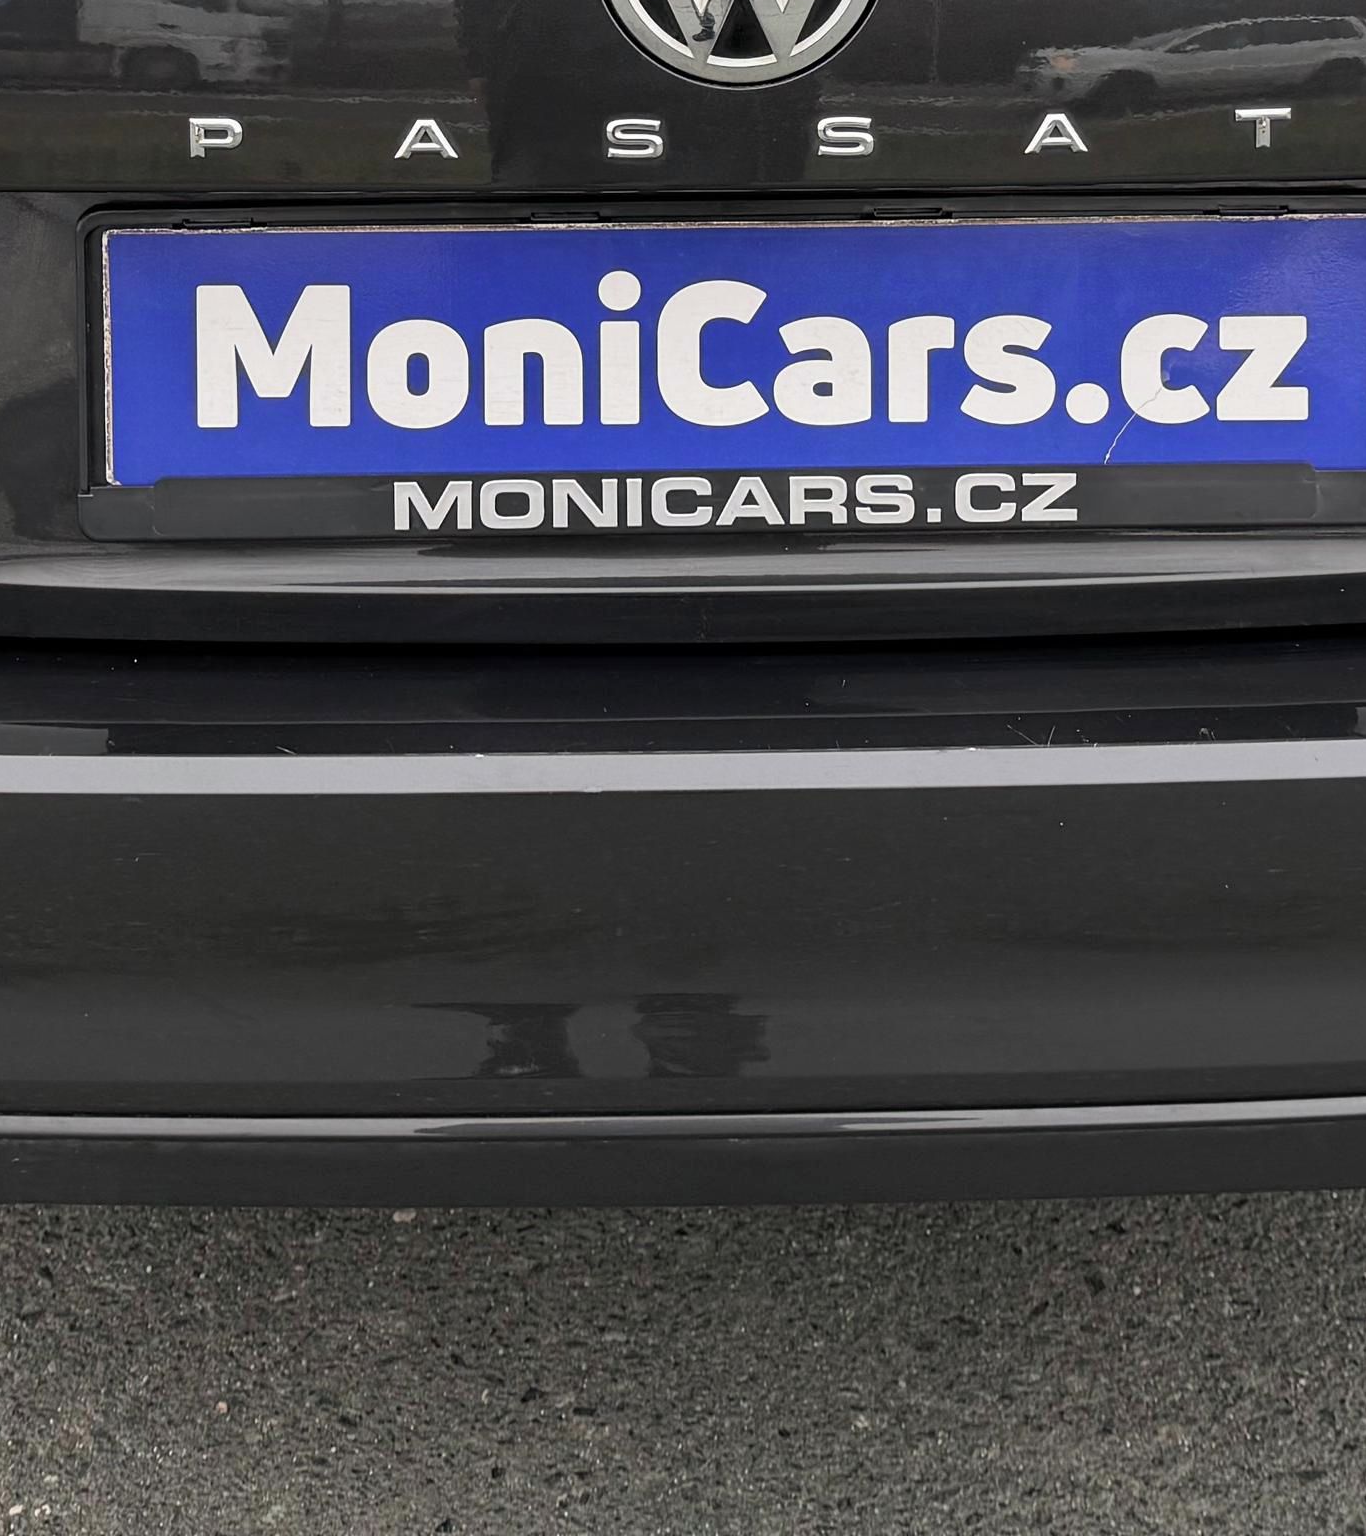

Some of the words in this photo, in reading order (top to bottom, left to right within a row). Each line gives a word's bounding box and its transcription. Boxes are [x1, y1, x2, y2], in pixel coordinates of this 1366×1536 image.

[188, 107, 1292, 160] PASSAT
[195, 270, 1310, 429] MoniCars.cz
[393, 472, 1078, 531] MONICARS.CZ
